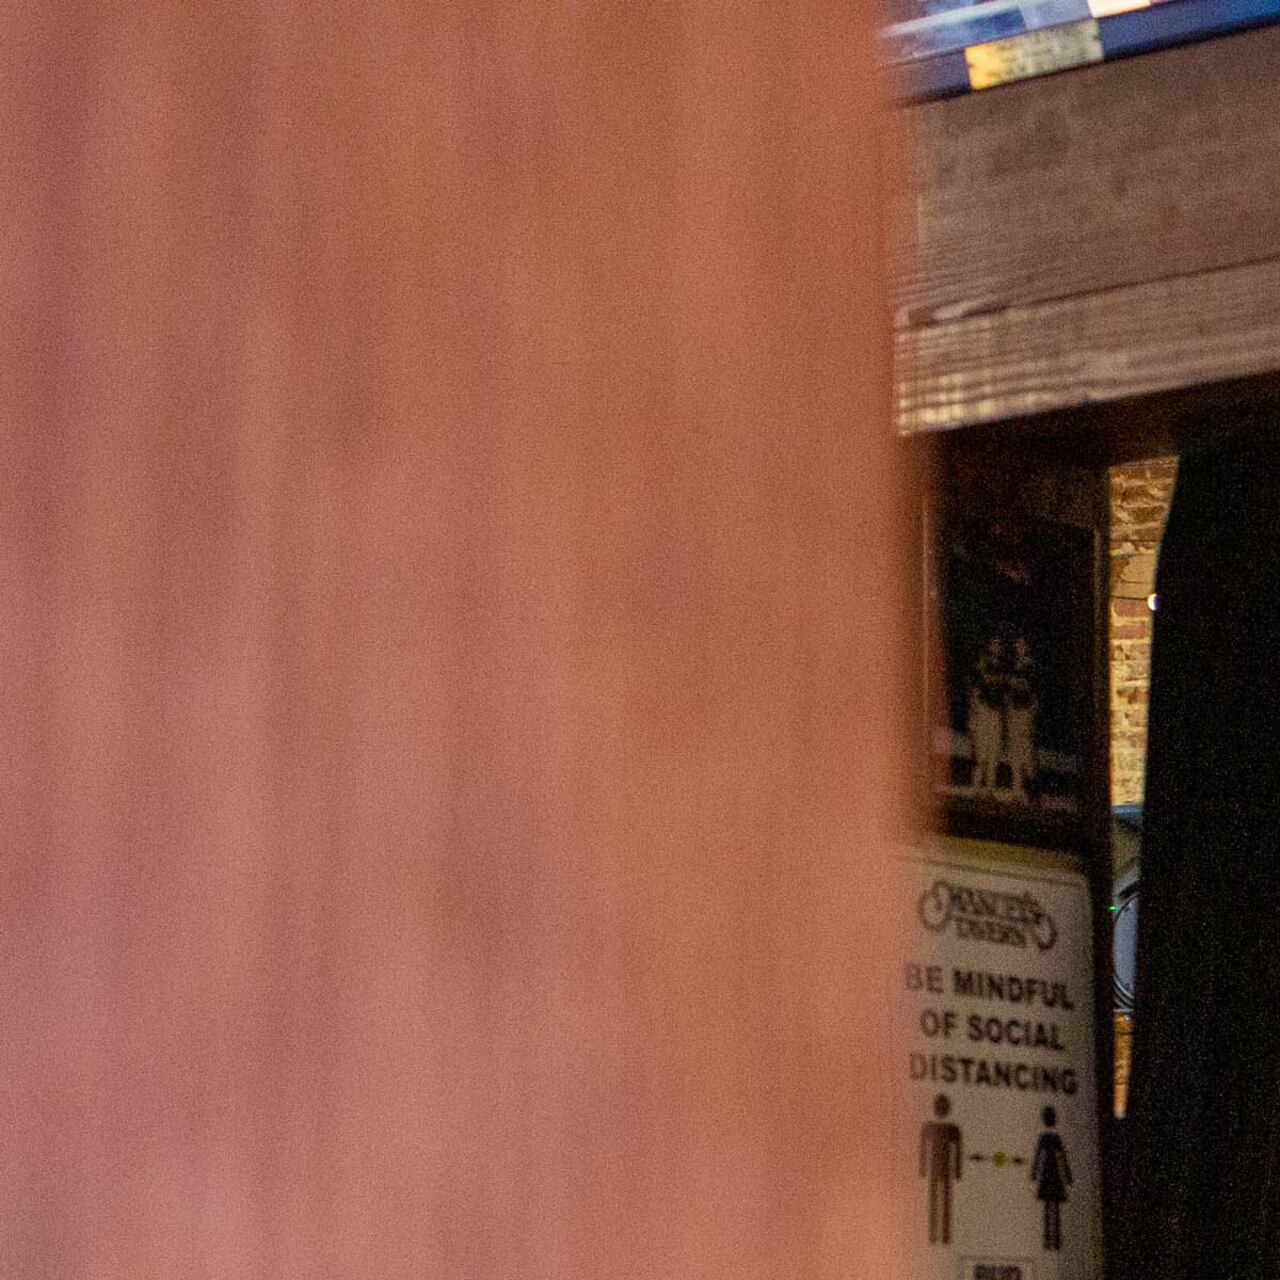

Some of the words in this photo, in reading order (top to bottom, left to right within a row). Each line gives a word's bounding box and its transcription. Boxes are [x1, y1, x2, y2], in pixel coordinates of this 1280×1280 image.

[903, 962, 944, 994] BE
[952, 969, 1074, 1011] MINDFUL
[919, 1008, 959, 1038] OF
[967, 1013, 1065, 1051] SOCIAL
[908, 1053, 1078, 1095] DISTANCING
